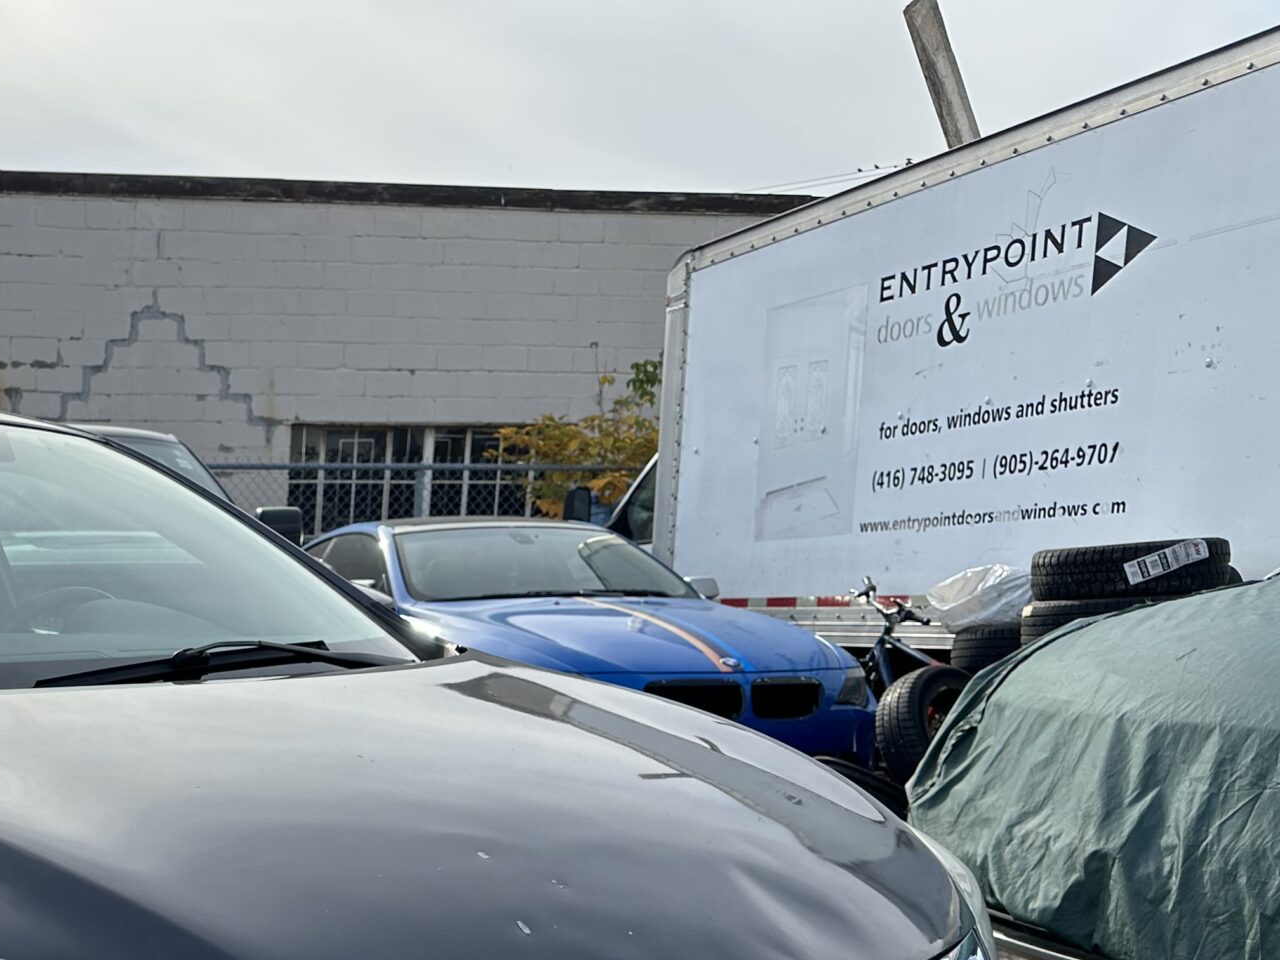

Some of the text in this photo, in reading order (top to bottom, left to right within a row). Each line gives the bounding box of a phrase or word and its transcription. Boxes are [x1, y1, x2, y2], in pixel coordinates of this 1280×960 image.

[879, 215, 1093, 303] ENTRYPOINT
[877, 273, 1085, 348] doors & windows
[879, 388, 1119, 440] for doors, windows and shutters
[872, 467, 905, 493] (416)
[910, 460, 974, 486] 748-3095
